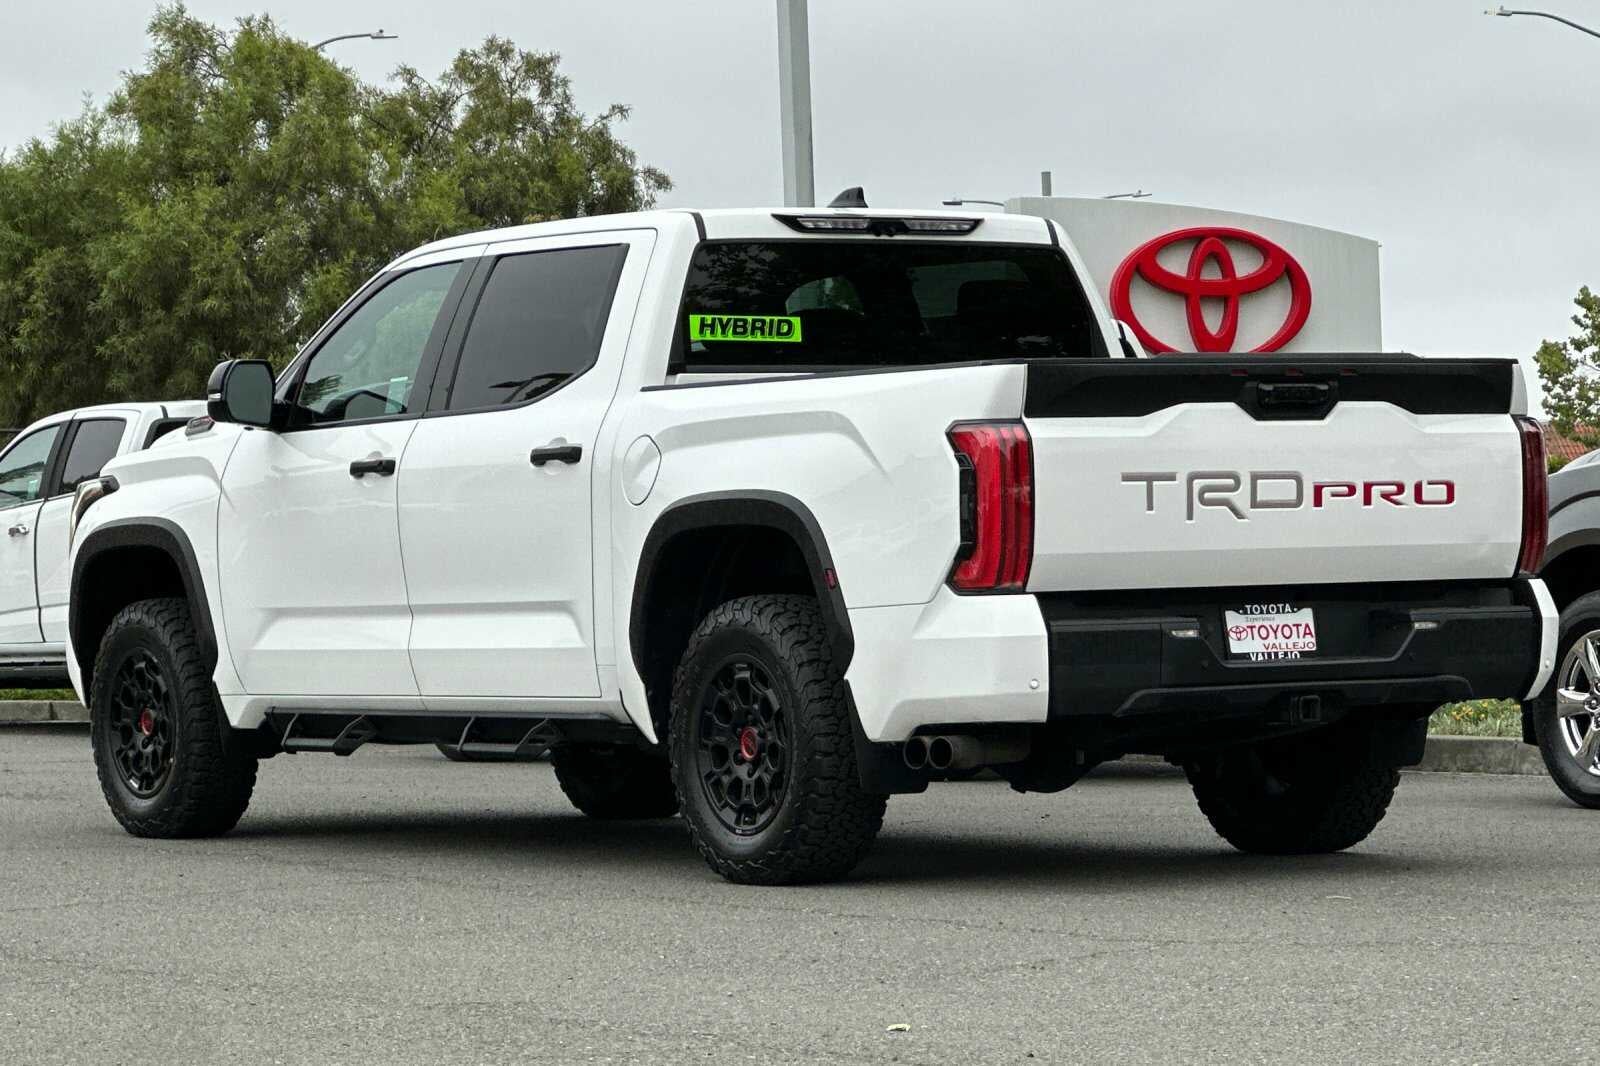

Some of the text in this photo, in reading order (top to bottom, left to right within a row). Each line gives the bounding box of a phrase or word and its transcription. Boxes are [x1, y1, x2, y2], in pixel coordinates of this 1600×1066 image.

[698, 316, 794, 338] HYBRID
[1121, 470, 1455, 522] TRD PRO
[1245, 603, 1292, 615] TOYOTA
[1247, 623, 1314, 641] TOYOTA
[1263, 641, 1316, 651] VALLEJO
